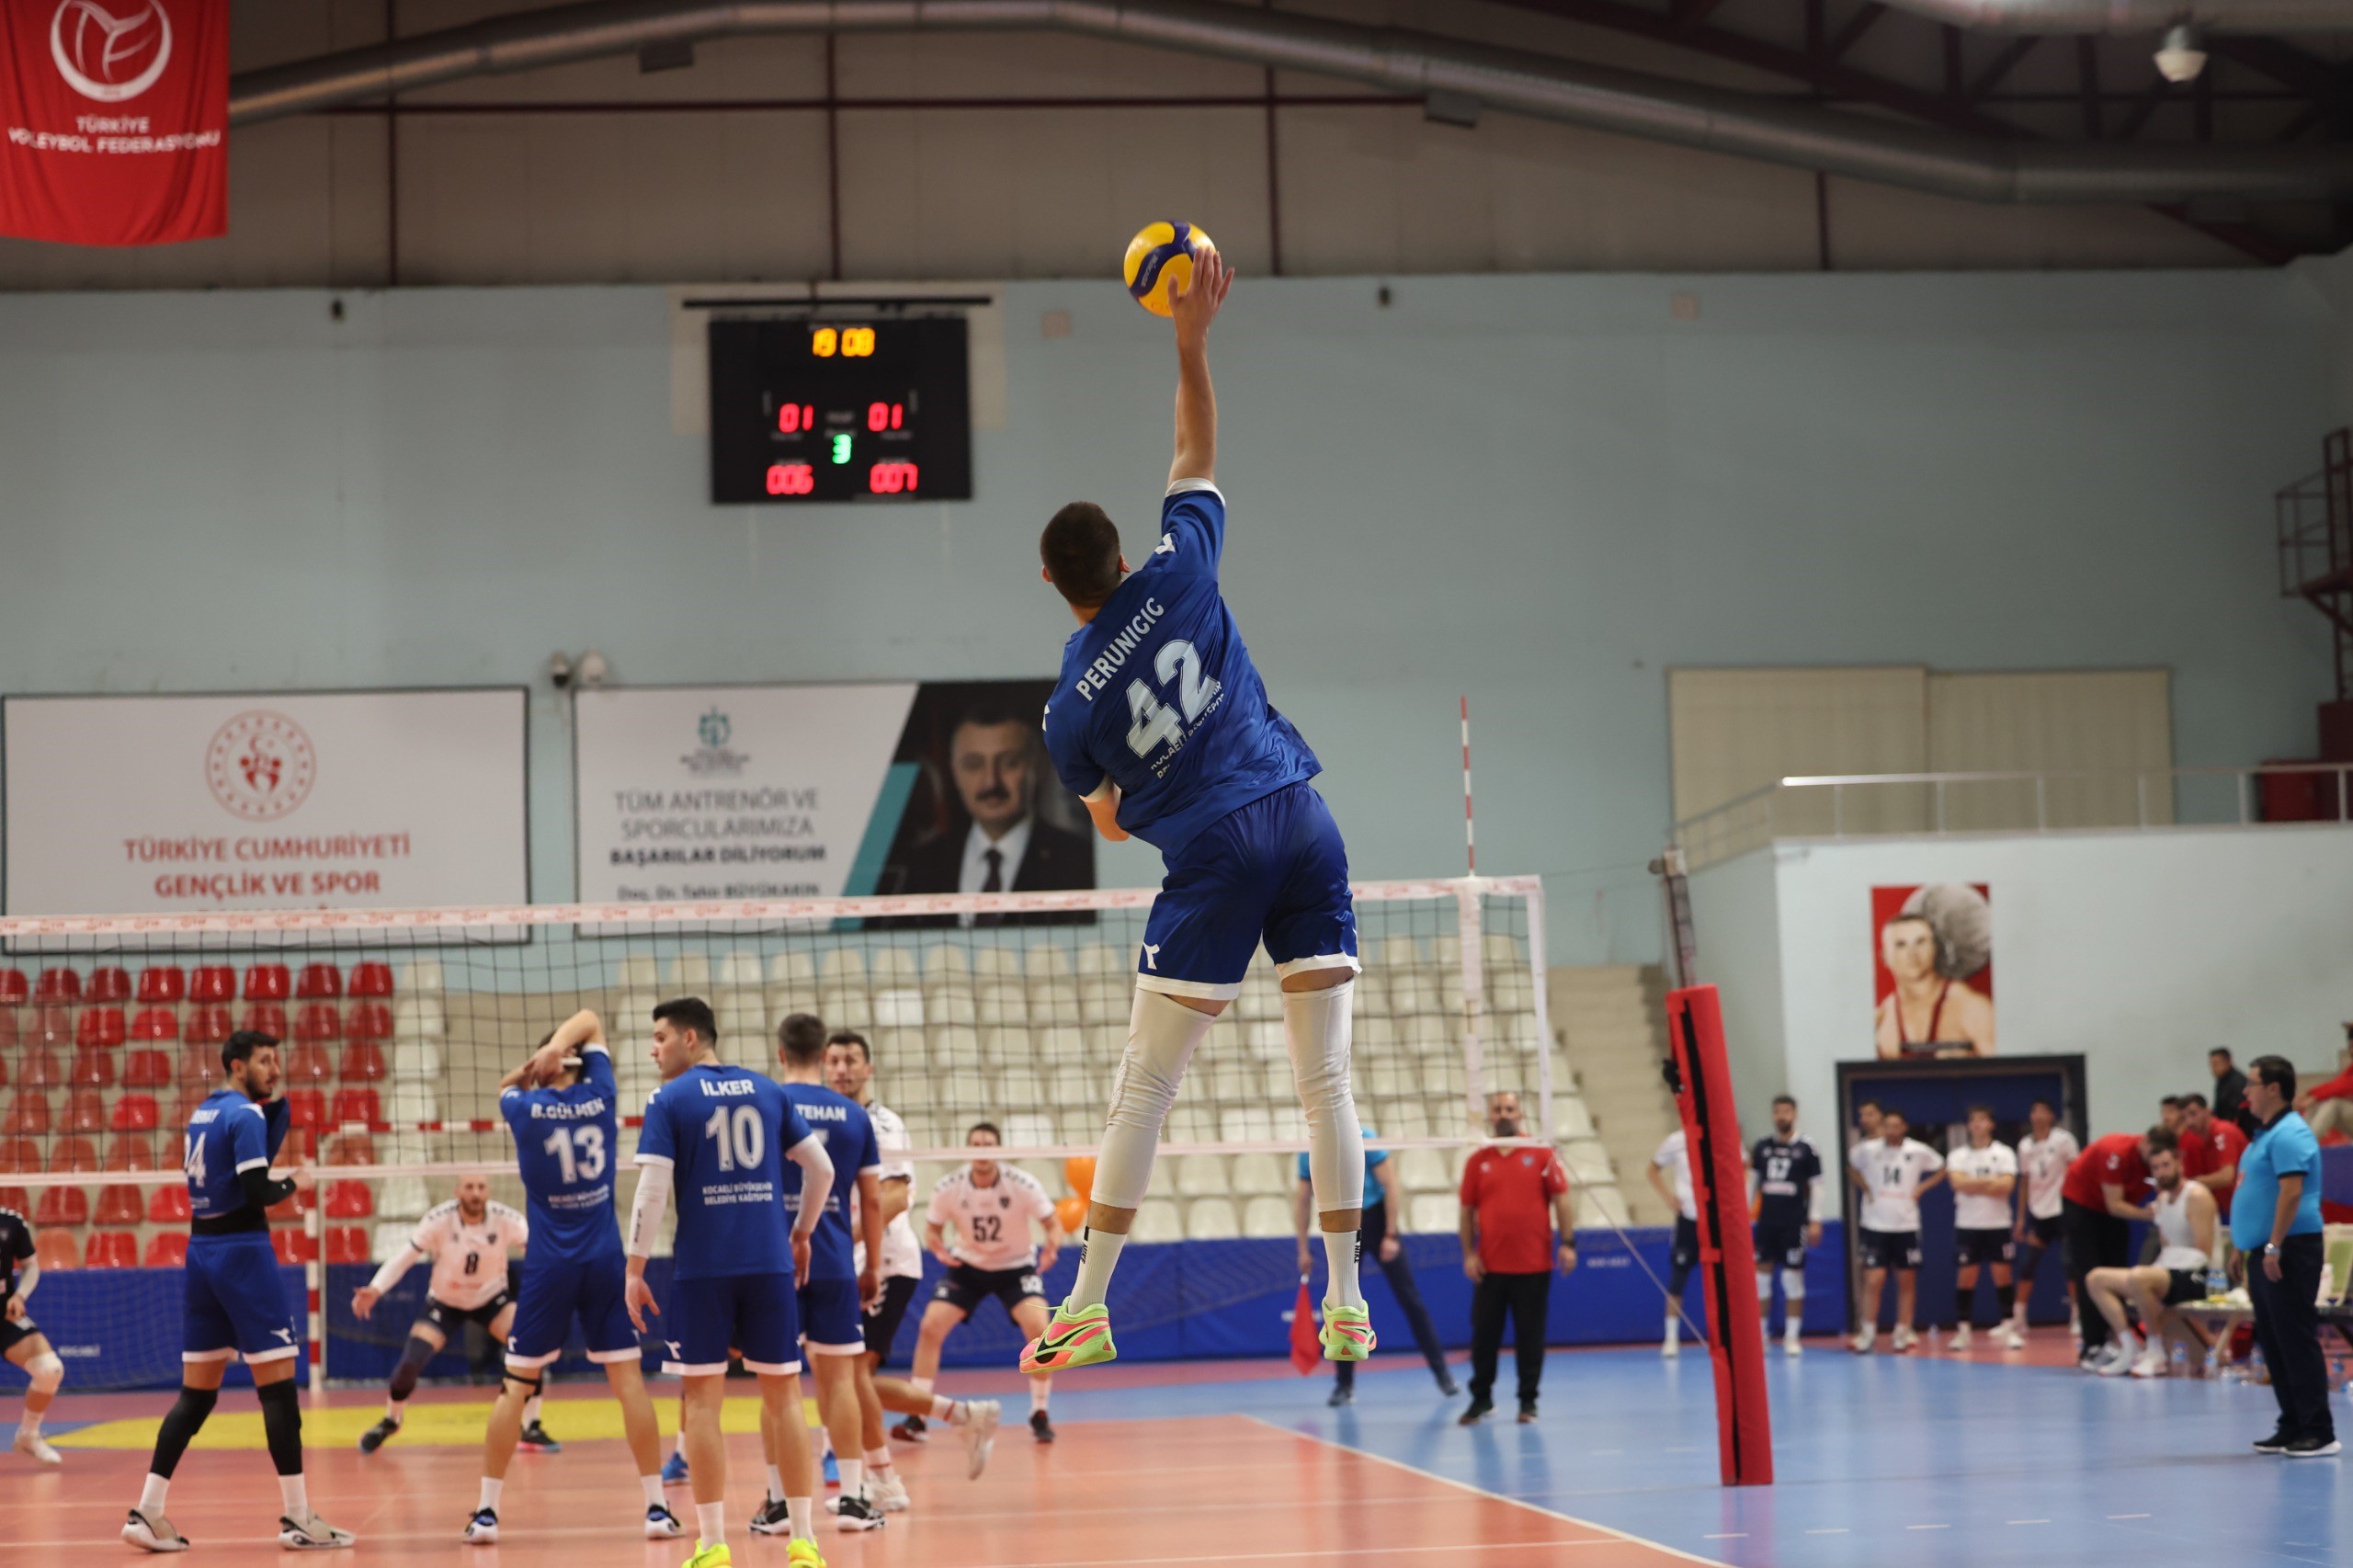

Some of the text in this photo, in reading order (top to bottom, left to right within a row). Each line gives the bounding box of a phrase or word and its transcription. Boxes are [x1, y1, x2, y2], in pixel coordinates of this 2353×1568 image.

[75, 113, 150, 133] TÜRKİYE
[97, 130, 221, 153] FEDERASYONU
[779, 403, 814, 433] 01
[868, 402, 904, 432] 01
[832, 433, 852, 464] 3
[870, 462, 918, 494] 007
[1126, 639, 1222, 759] 42
[615, 786, 819, 812] TÜM ANTRENÖR VE
[620, 817, 814, 841] SPORCULARIMIZA
[124, 832, 411, 863] TÜRKİYE CUMHURİYETİ
[610, 845, 825, 869] BAŞARILAR DİLİYORUM
[154, 870, 381, 902] GENÇLİK VE SPOR
[699, 1078, 756, 1096] İLKER
[795, 1103, 847, 1122] TEHAN
[705, 1105, 765, 1172] 10
[543, 1124, 606, 1184] 13
[972, 1215, 1001, 1242] 52
